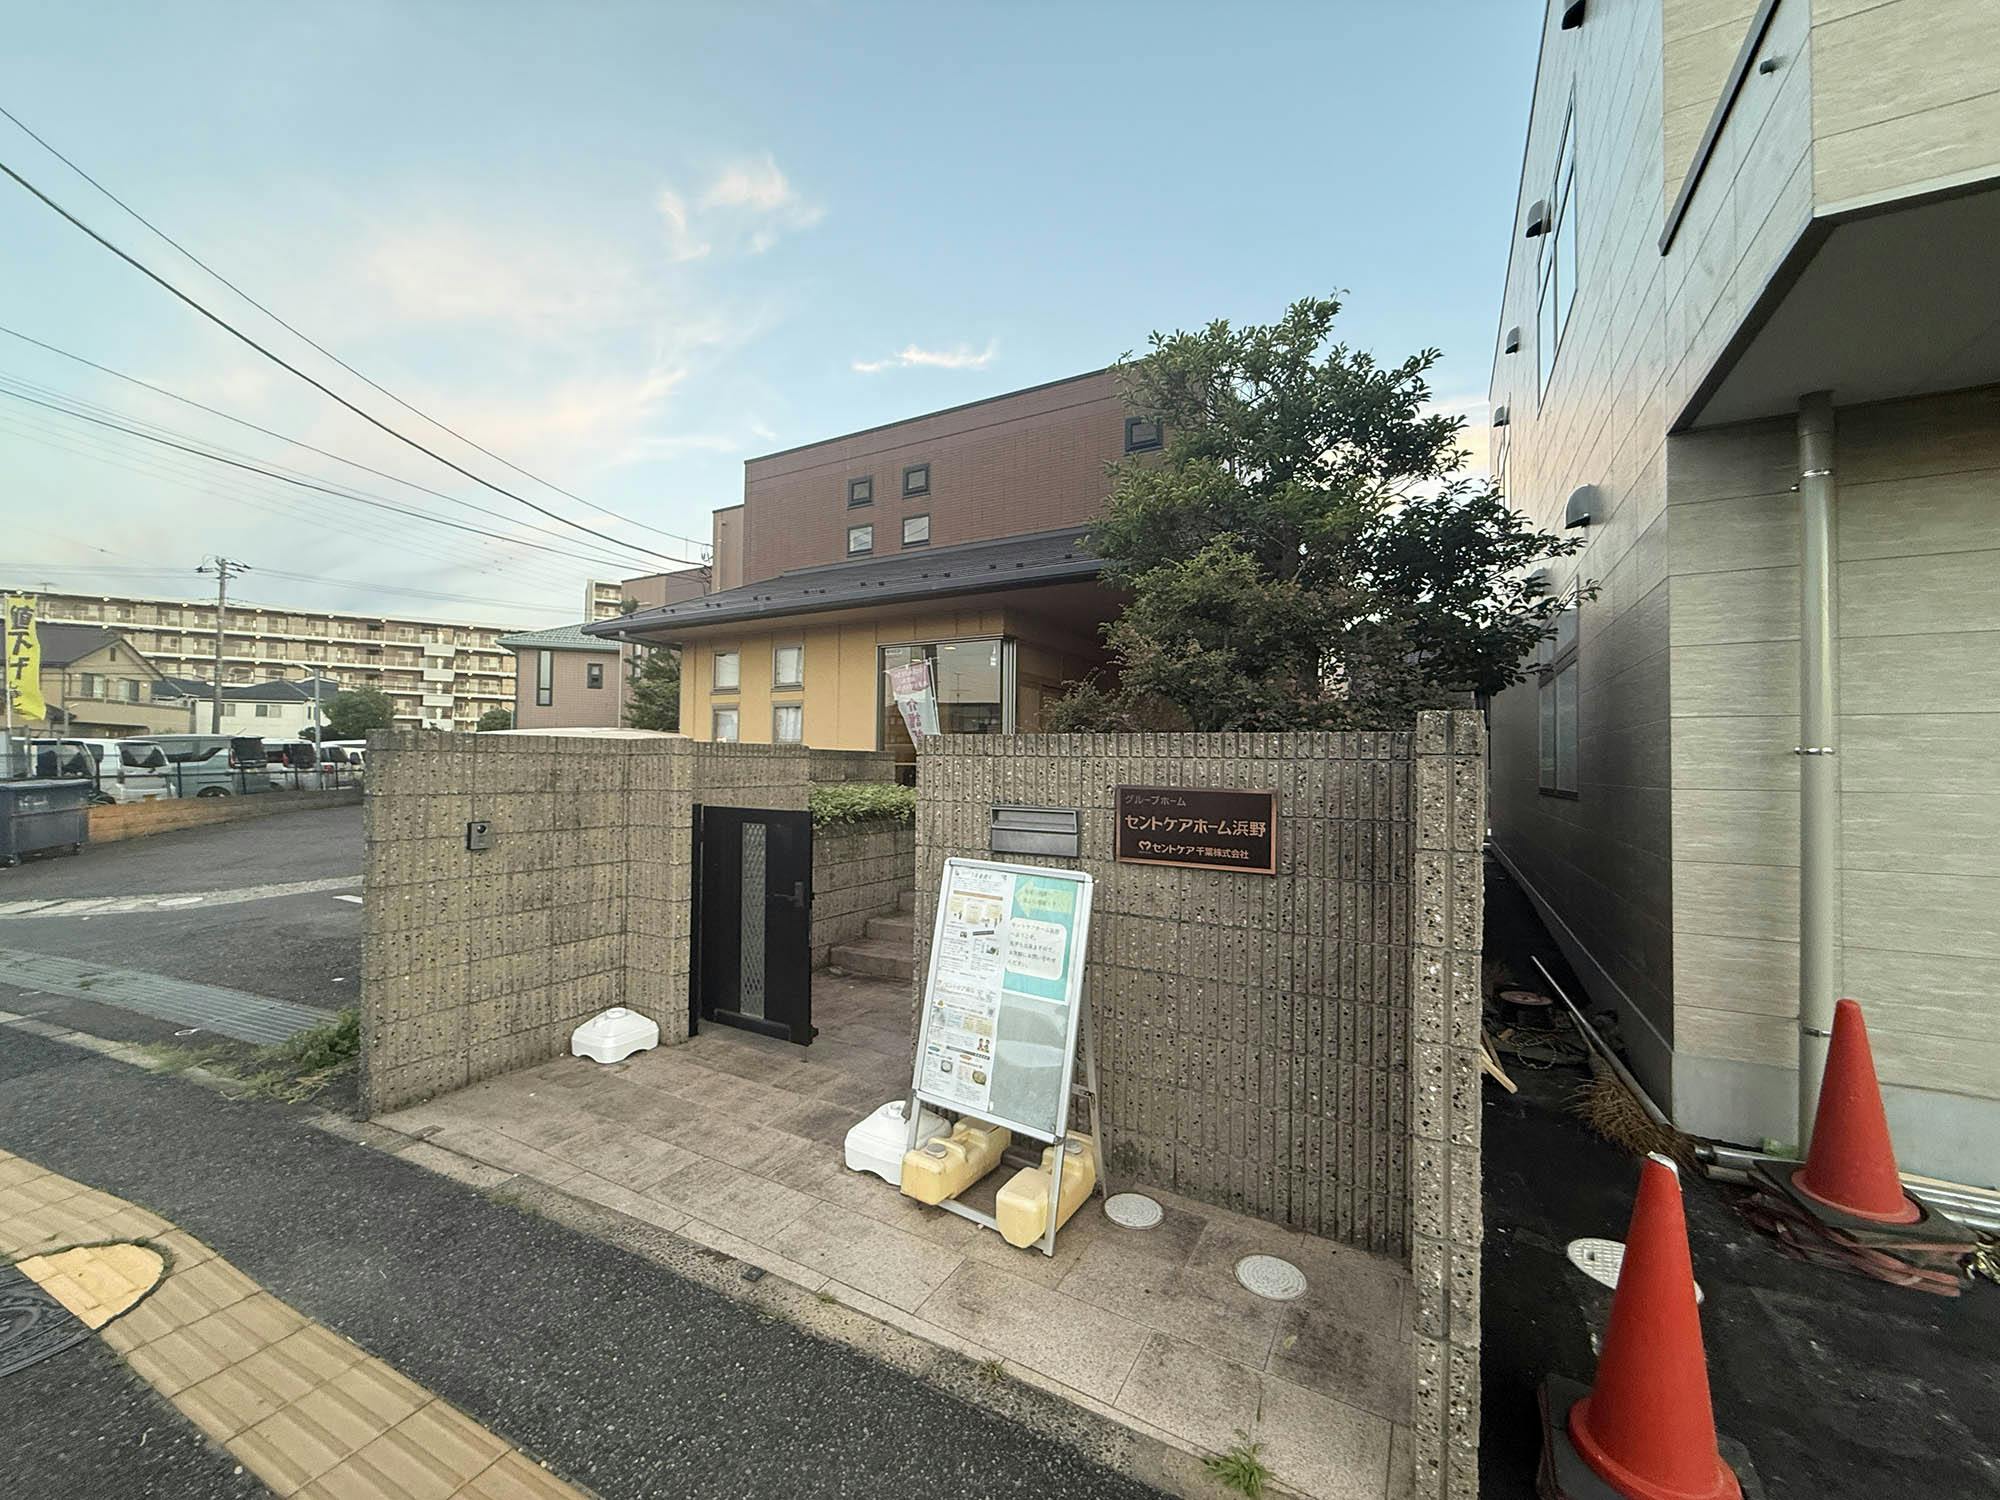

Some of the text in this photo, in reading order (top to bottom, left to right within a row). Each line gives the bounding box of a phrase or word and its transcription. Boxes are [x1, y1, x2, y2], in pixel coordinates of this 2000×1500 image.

[1124, 794, 1187, 807] グループホーム
[1124, 814, 1267, 838] セントケアホーム浜野
[1152, 842, 1250, 860] セントケア千葉株式会社
